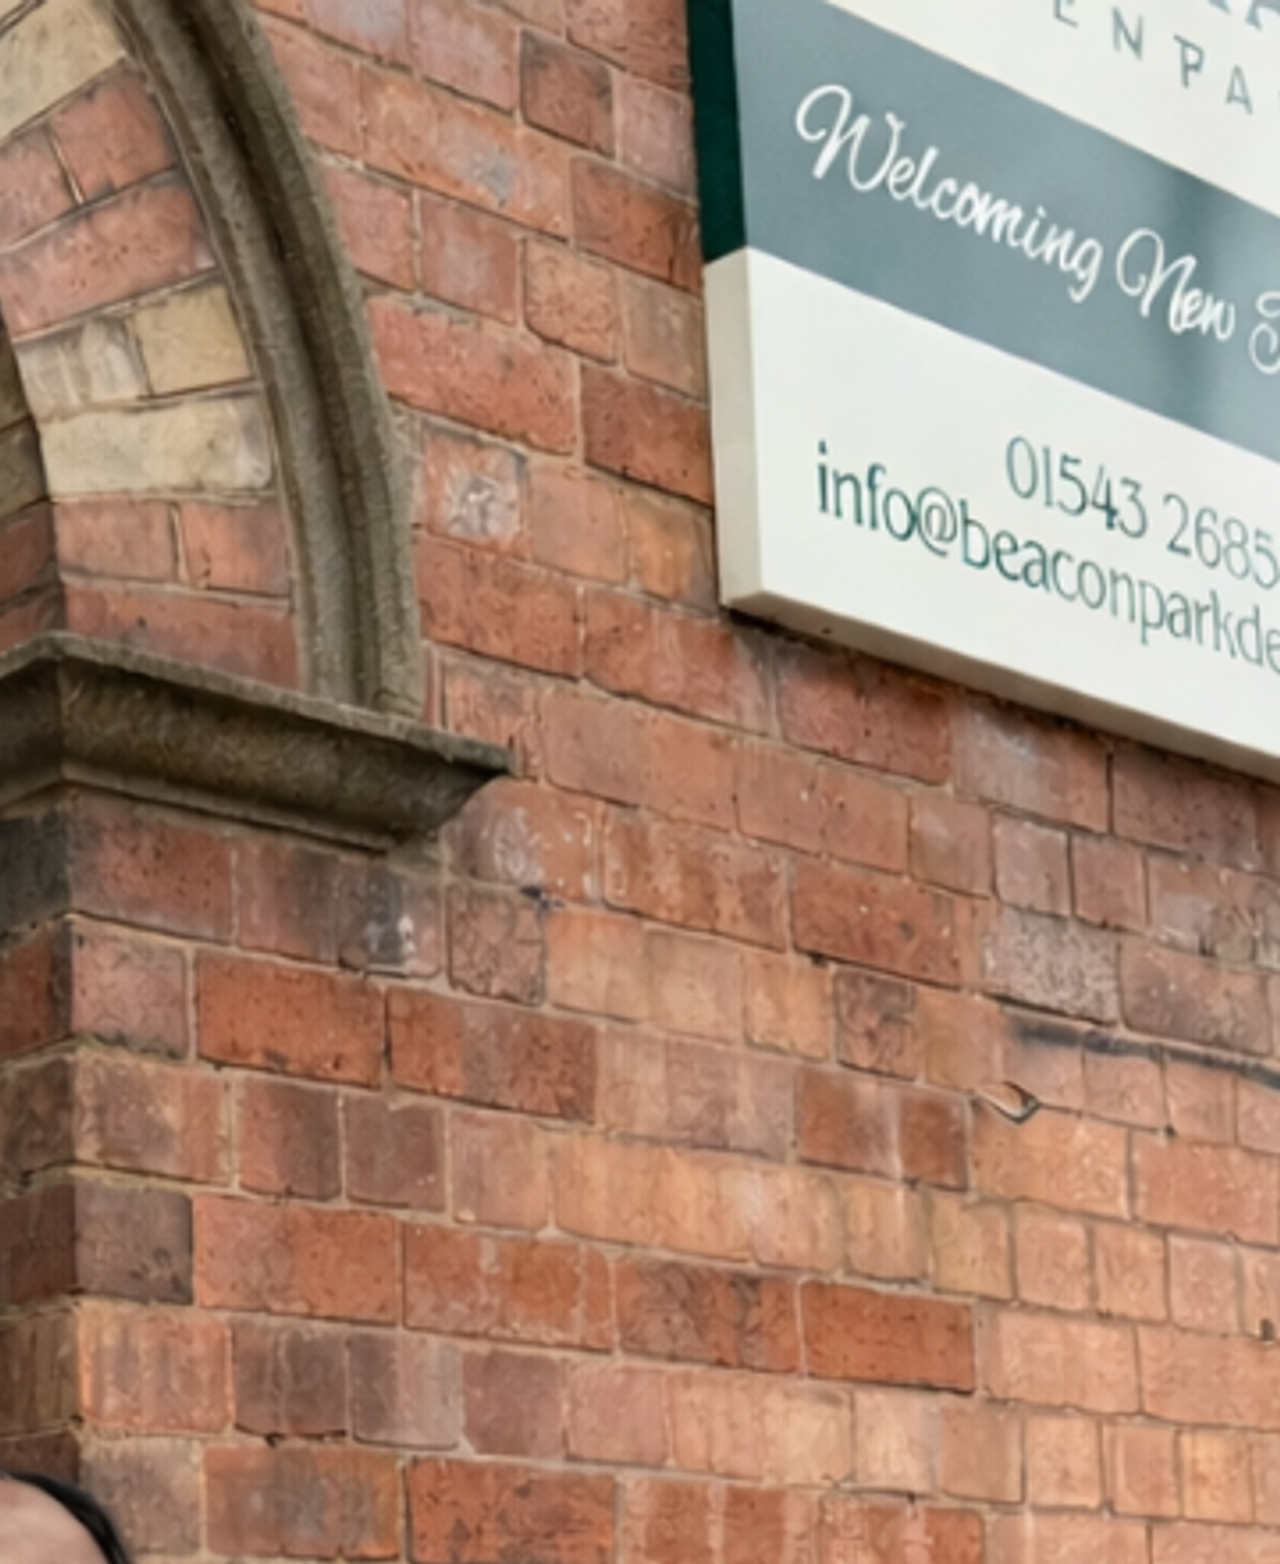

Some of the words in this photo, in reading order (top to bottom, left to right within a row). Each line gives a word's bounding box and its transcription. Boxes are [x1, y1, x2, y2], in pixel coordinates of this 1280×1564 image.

[795, 84, 1104, 303] Welcoming
[1116, 228, 1236, 342] New
[817, 440, 1280, 677] info@beaconparkde
[1006, 436, 1148, 539] 01543
[1163, 492, 1280, 590] 2685
